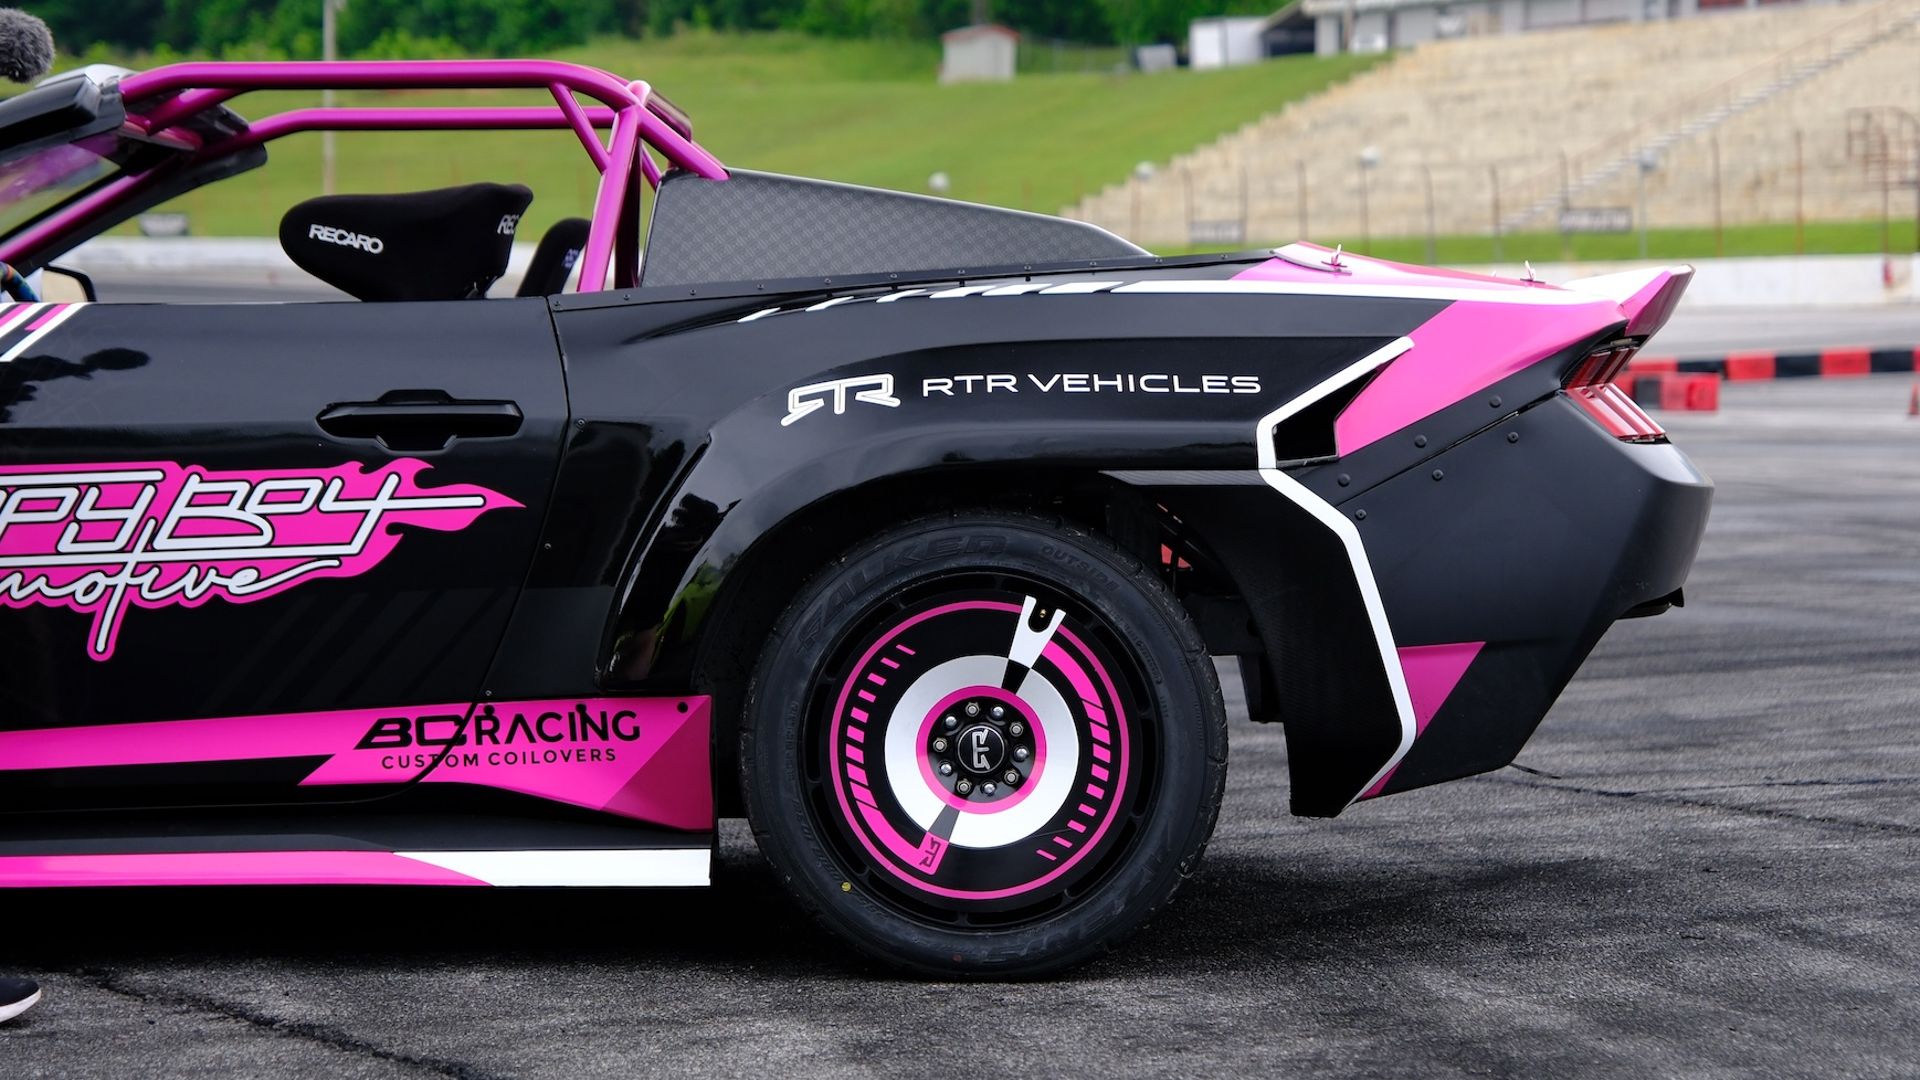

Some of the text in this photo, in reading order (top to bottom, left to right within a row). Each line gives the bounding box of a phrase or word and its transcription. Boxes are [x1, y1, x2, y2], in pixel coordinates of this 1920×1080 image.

[309, 224, 384, 255] RECARO
[922, 374, 1262, 398] RTR VEHICLES
[474, 710, 641, 746] RACING
[381, 747, 617, 769] CUSTOM COILOVERS
